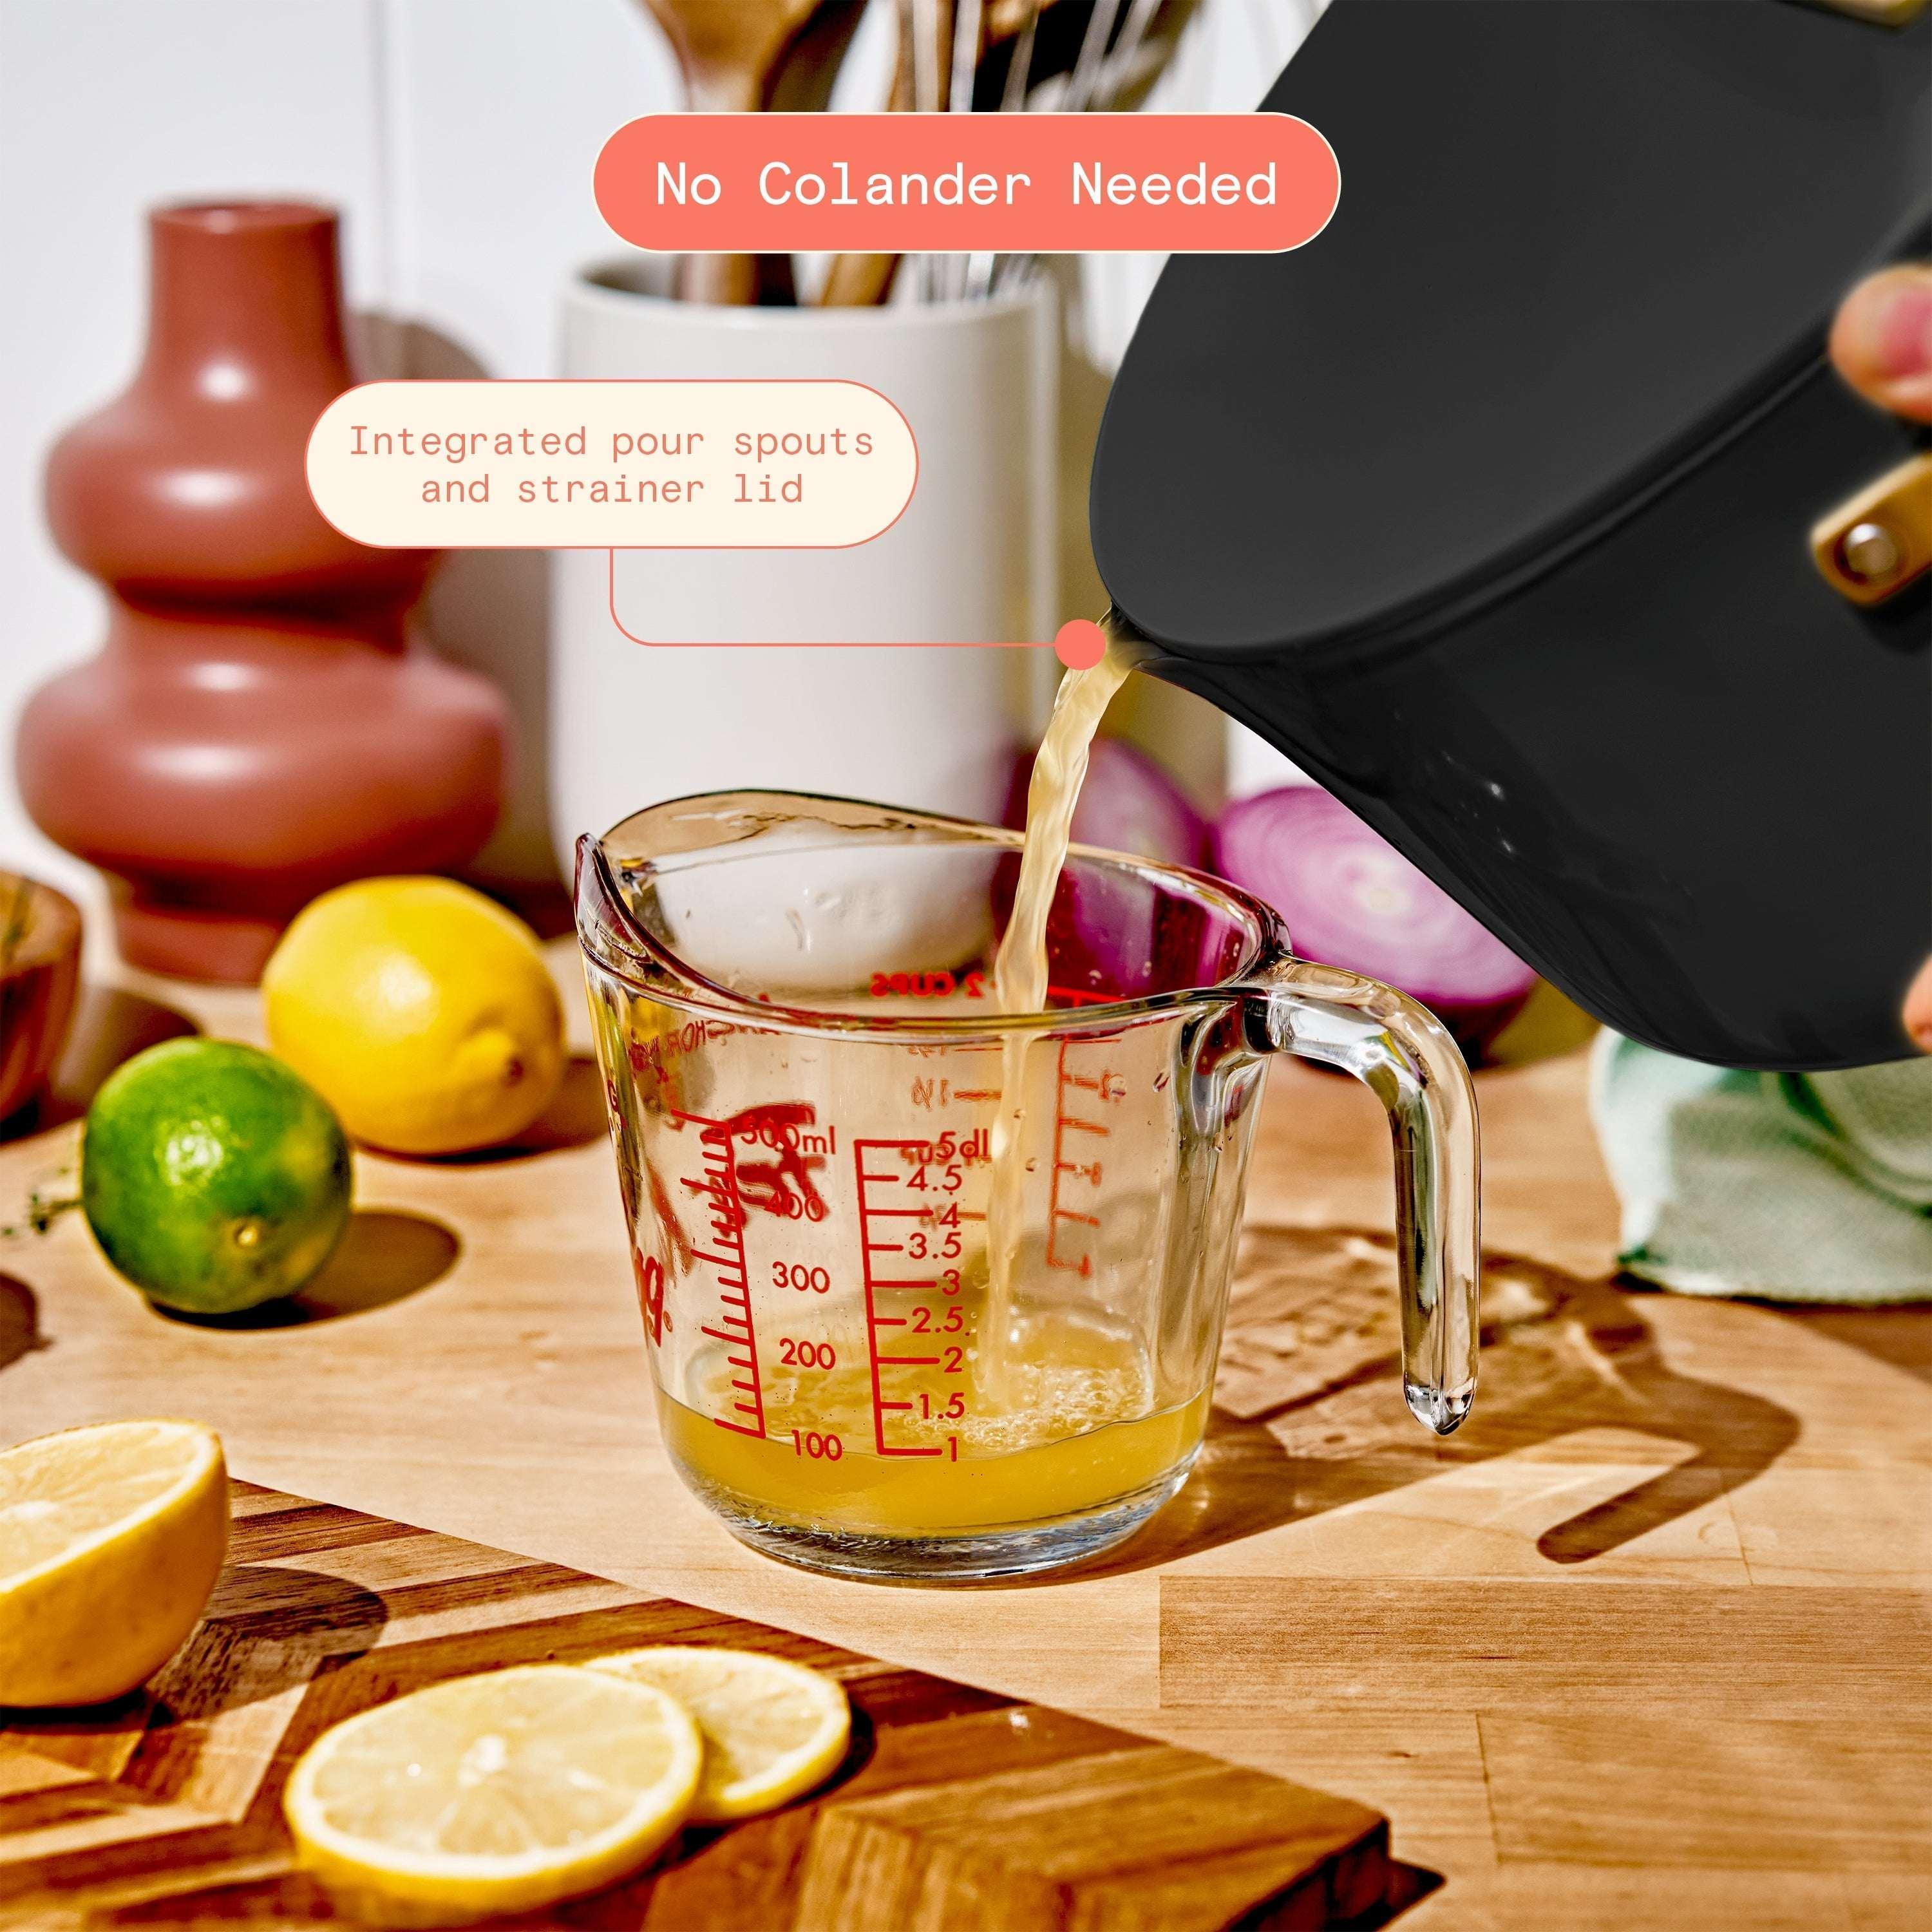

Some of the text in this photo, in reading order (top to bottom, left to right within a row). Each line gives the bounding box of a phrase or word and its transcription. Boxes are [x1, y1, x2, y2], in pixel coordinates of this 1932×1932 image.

[740, 1115, 835, 1155] 500ml
[935, 1128, 989, 1159] 5dl
[906, 1164, 963, 1193] 4.5
[764, 1191, 827, 1222] 400
[938, 1201, 961, 1229] 4
[908, 1231, 963, 1260] 3.5
[772, 1261, 831, 1294] 300
[942, 1269, 961, 1296] 3
[911, 1305, 964, 1334] 2.5
[779, 1338, 836, 1370] 200
[943, 1346, 964, 1374] 2
[918, 1392, 965, 1420] 1.5
[791, 1429, 842, 1461] 100
[947, 1436, 958, 1463] 1
